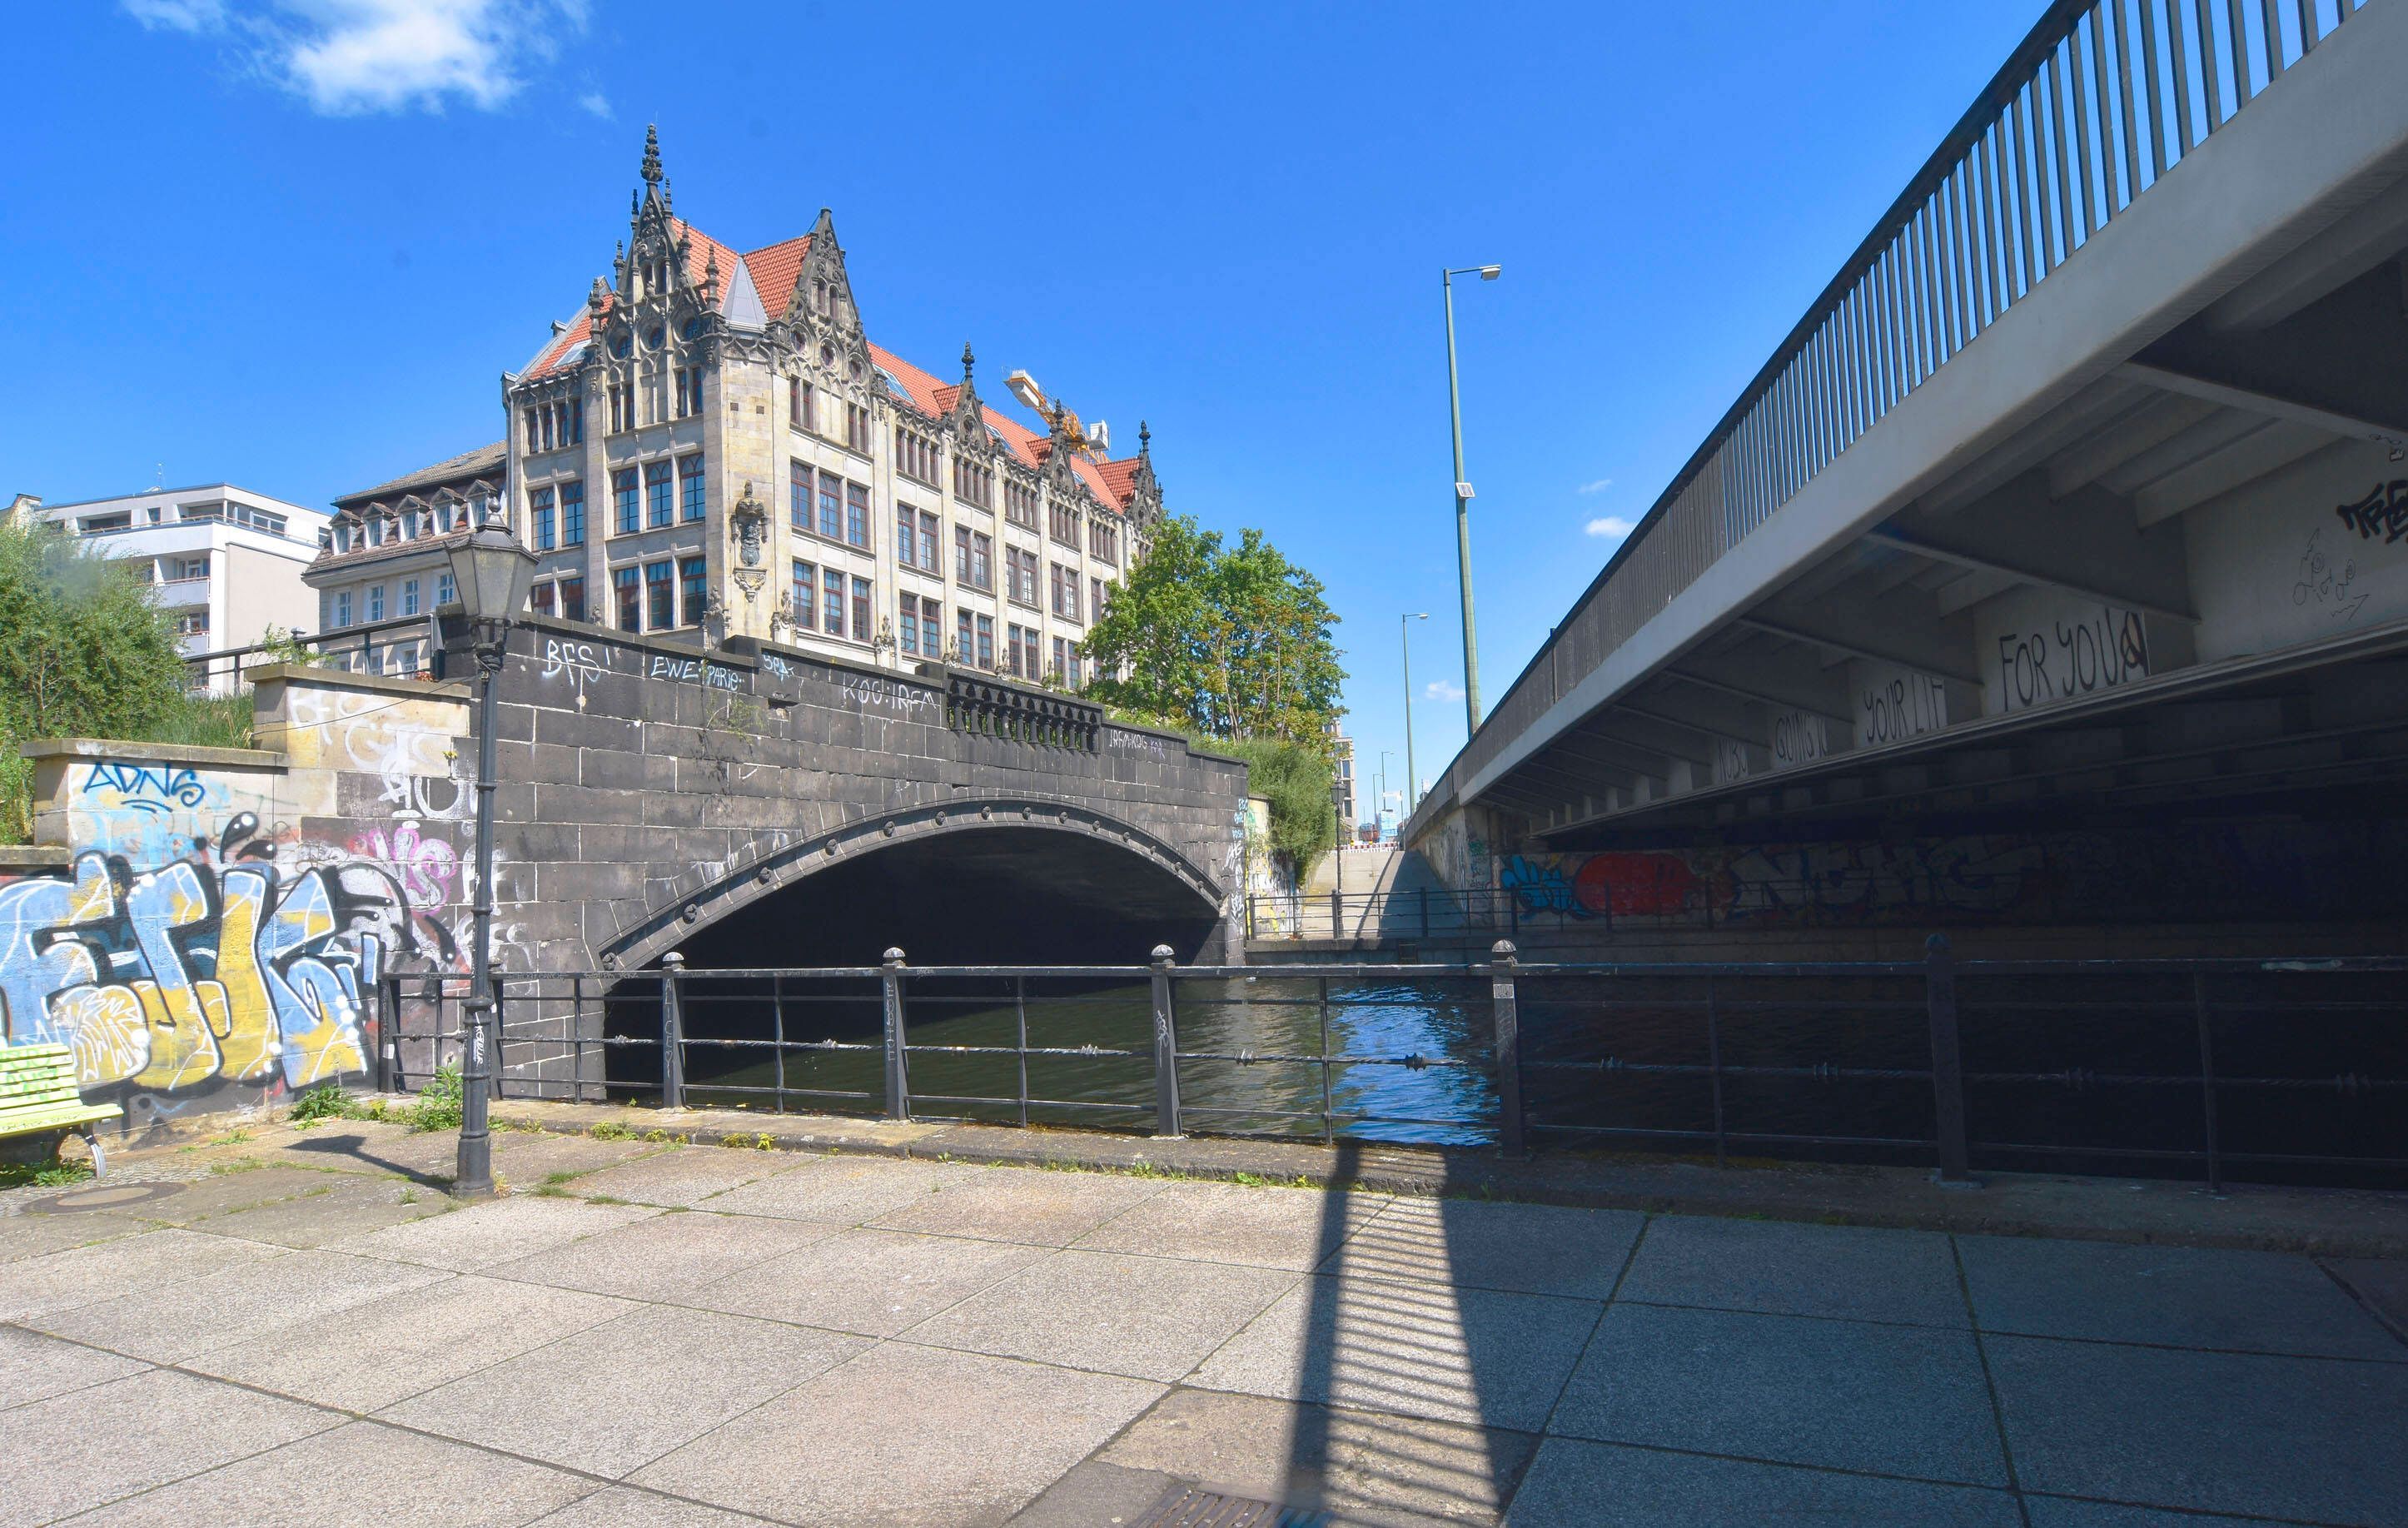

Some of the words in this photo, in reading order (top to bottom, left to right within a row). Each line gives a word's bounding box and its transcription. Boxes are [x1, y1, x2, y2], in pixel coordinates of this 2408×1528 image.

[1999, 633, 2054, 712] FOR
[2056, 607, 2117, 696] YOU
[1864, 679, 1908, 743] YOUR
[1911, 674, 1943, 733] LIF
